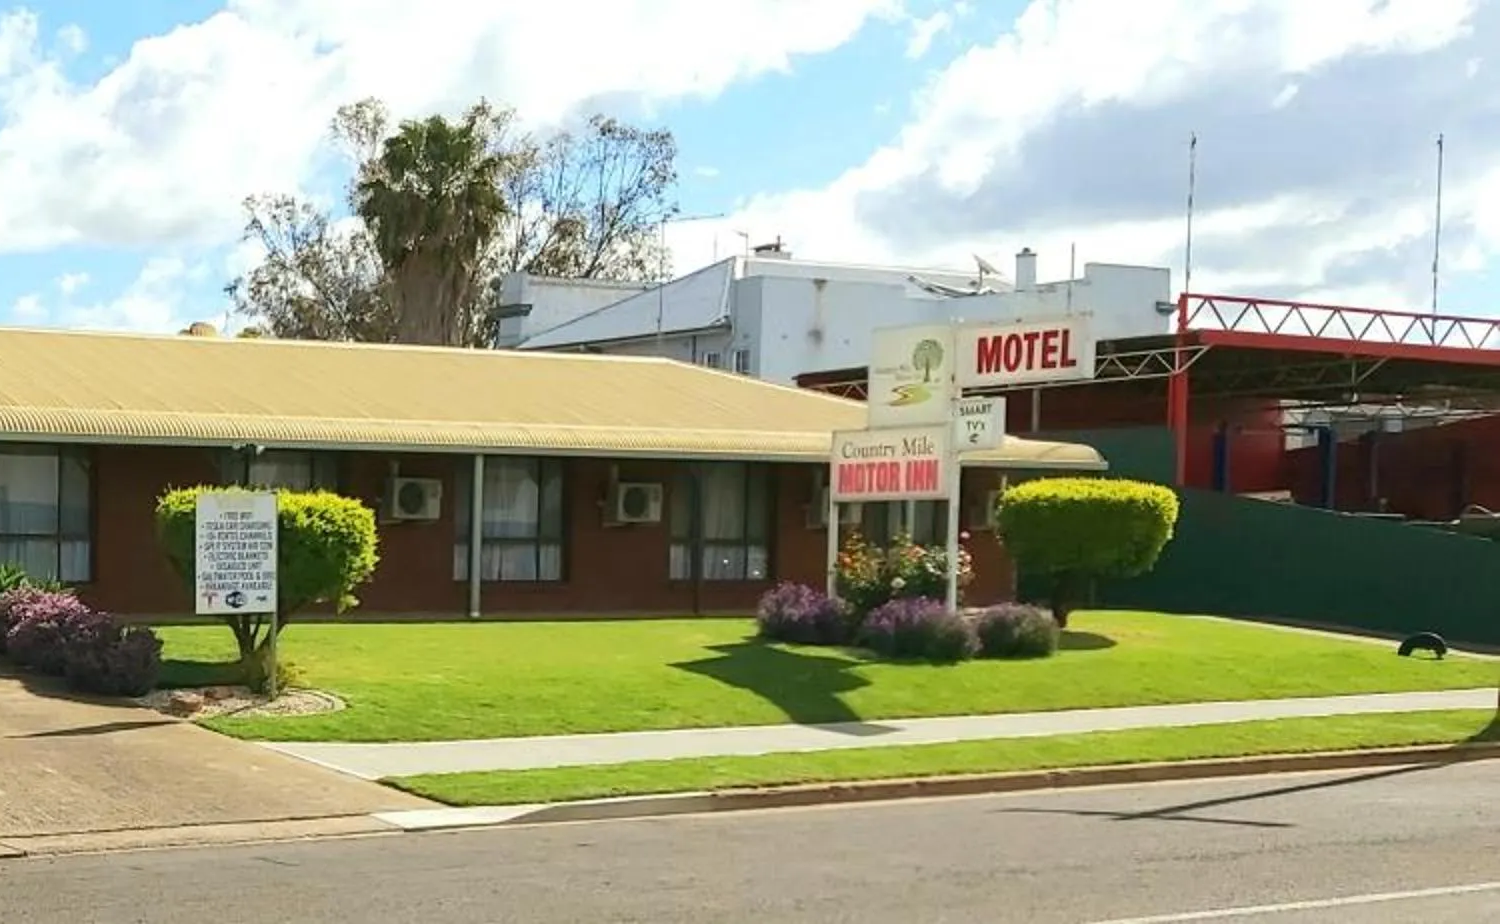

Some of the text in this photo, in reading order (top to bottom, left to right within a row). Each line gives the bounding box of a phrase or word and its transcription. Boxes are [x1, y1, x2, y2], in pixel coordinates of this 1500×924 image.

[976, 329, 1077, 374] MOTEL
[959, 403, 992, 416] SMART
[841, 435, 935, 459] Country Mile
[838, 459, 938, 493] MOTOR INN
